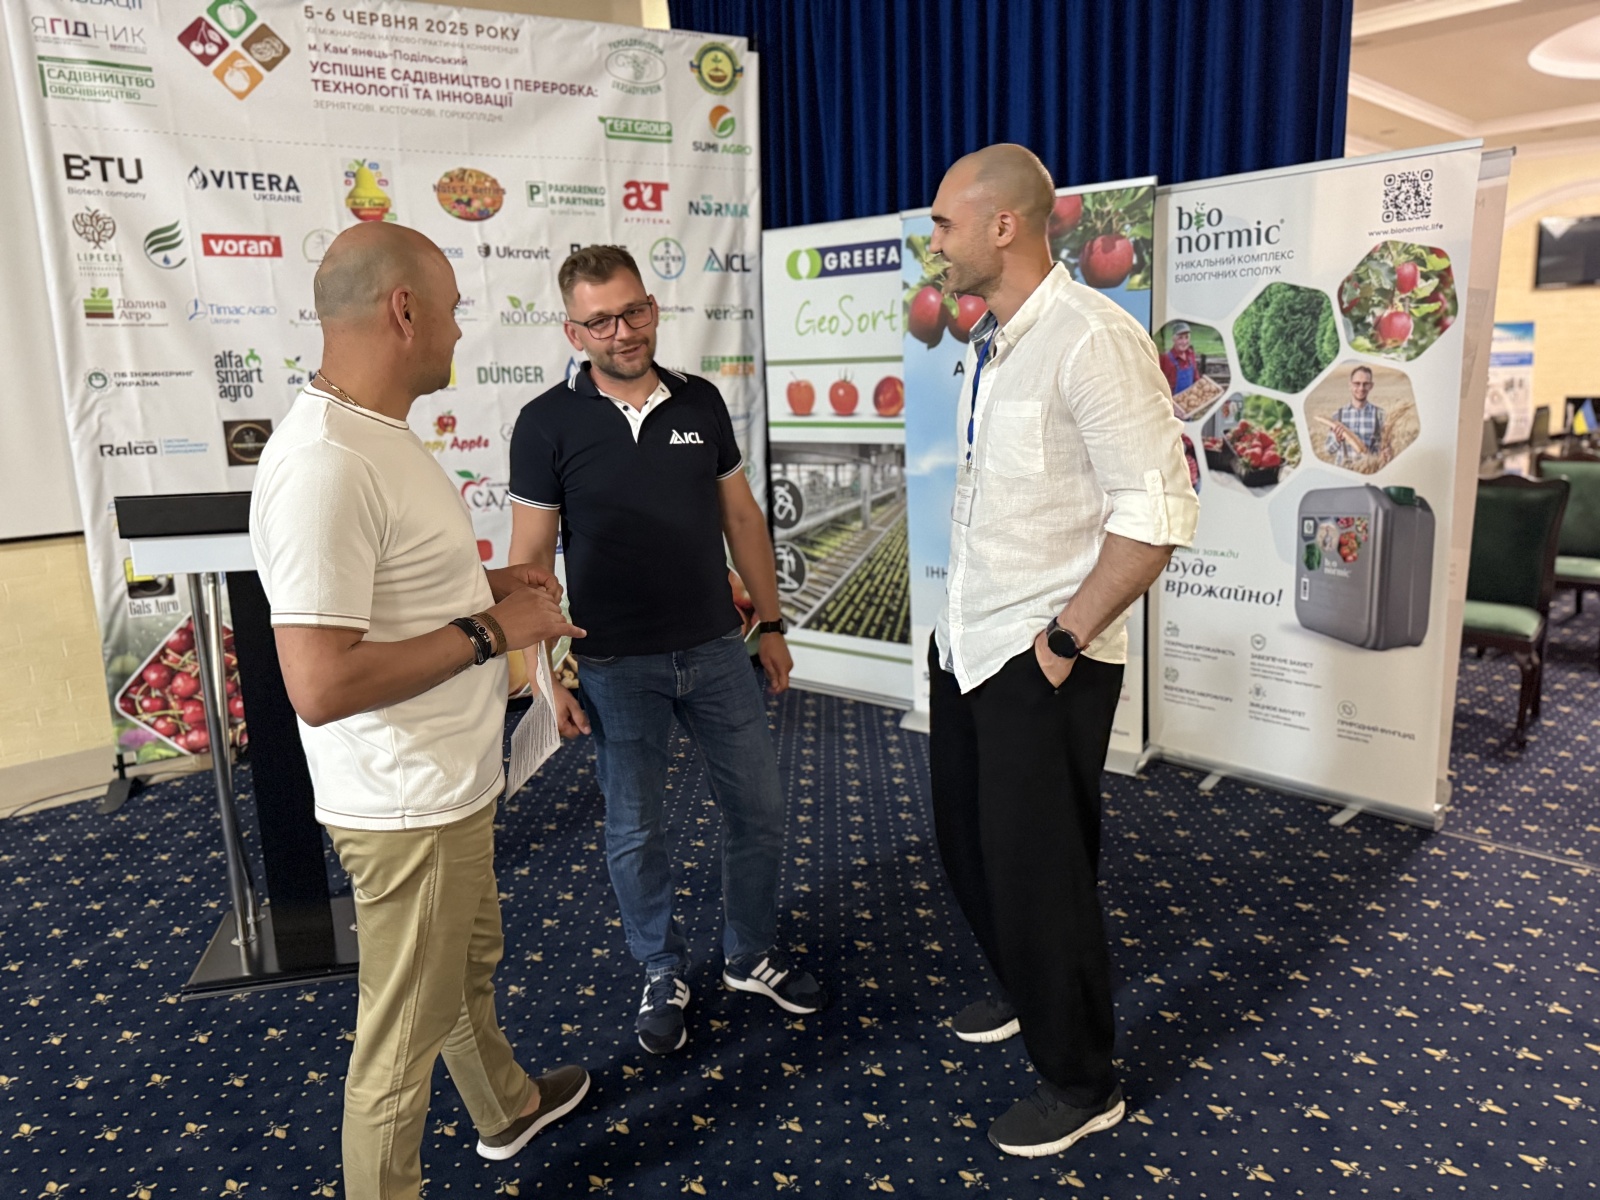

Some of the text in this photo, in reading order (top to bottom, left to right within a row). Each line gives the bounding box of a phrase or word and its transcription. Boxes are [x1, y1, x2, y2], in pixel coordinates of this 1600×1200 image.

[31, 16, 146, 44] ЯГІДНИК
[304, 5, 520, 41] 5-6 ЧЕРВНЯ 2025 РОКУ
[46, 67, 155, 88] САДІВНИЦТВО
[310, 60, 598, 98] УСПІШНЕ САДІВНИЦТВО І ПЕРЕРОБКА:
[48, 84, 141, 101] ОВОЧІВНИЦТВО
[311, 78, 513, 108] ТЕХНОЛОГІЇ ТА ІННОВАЦІЇ
[693, 141, 752, 155] SUMI AGRO
[63, 153, 143, 184] BTU
[210, 169, 300, 193] VITERA
[548, 183, 606, 196] PAKHARENKO
[67, 186, 146, 200] Biotech company
[253, 193, 302, 203] UKRAINE
[559, 195, 605, 207] PARTNERS
[688, 201, 750, 218] NORMA
[1176, 220, 1280, 254] normic
[1368, 223, 1443, 237] www.bionormic.life
[208, 239, 273, 255] voran
[496, 246, 551, 260] Ukravit
[725, 253, 752, 272] ICL
[824, 245, 900, 271] GREEFA
[1175, 249, 1295, 271] УНІКАЛЬНИЙ КОМПЛЕКС
[1175, 265, 1282, 283] БІОЛОГІЧНИХ СПОЛУК
[117, 298, 167, 310] Долина
[208, 303, 278, 316] Timac AGRO
[119, 310, 152, 322] Агро
[795, 294, 898, 336] GeoSort
[214, 350, 244, 369] alfa
[216, 367, 263, 384] smart
[287, 374, 303, 385] de
[477, 361, 544, 385] DÜNGER
[115, 379, 160, 388] УКРАЇНА
[219, 384, 254, 403] agro
[450, 434, 489, 452] Apple
[683, 431, 704, 444] ICL
[99, 441, 158, 458] Ralco
[1166, 555, 1217, 579] Буде
[1165, 579, 1283, 607] врожайно!
[128, 600, 152, 616] Gals
